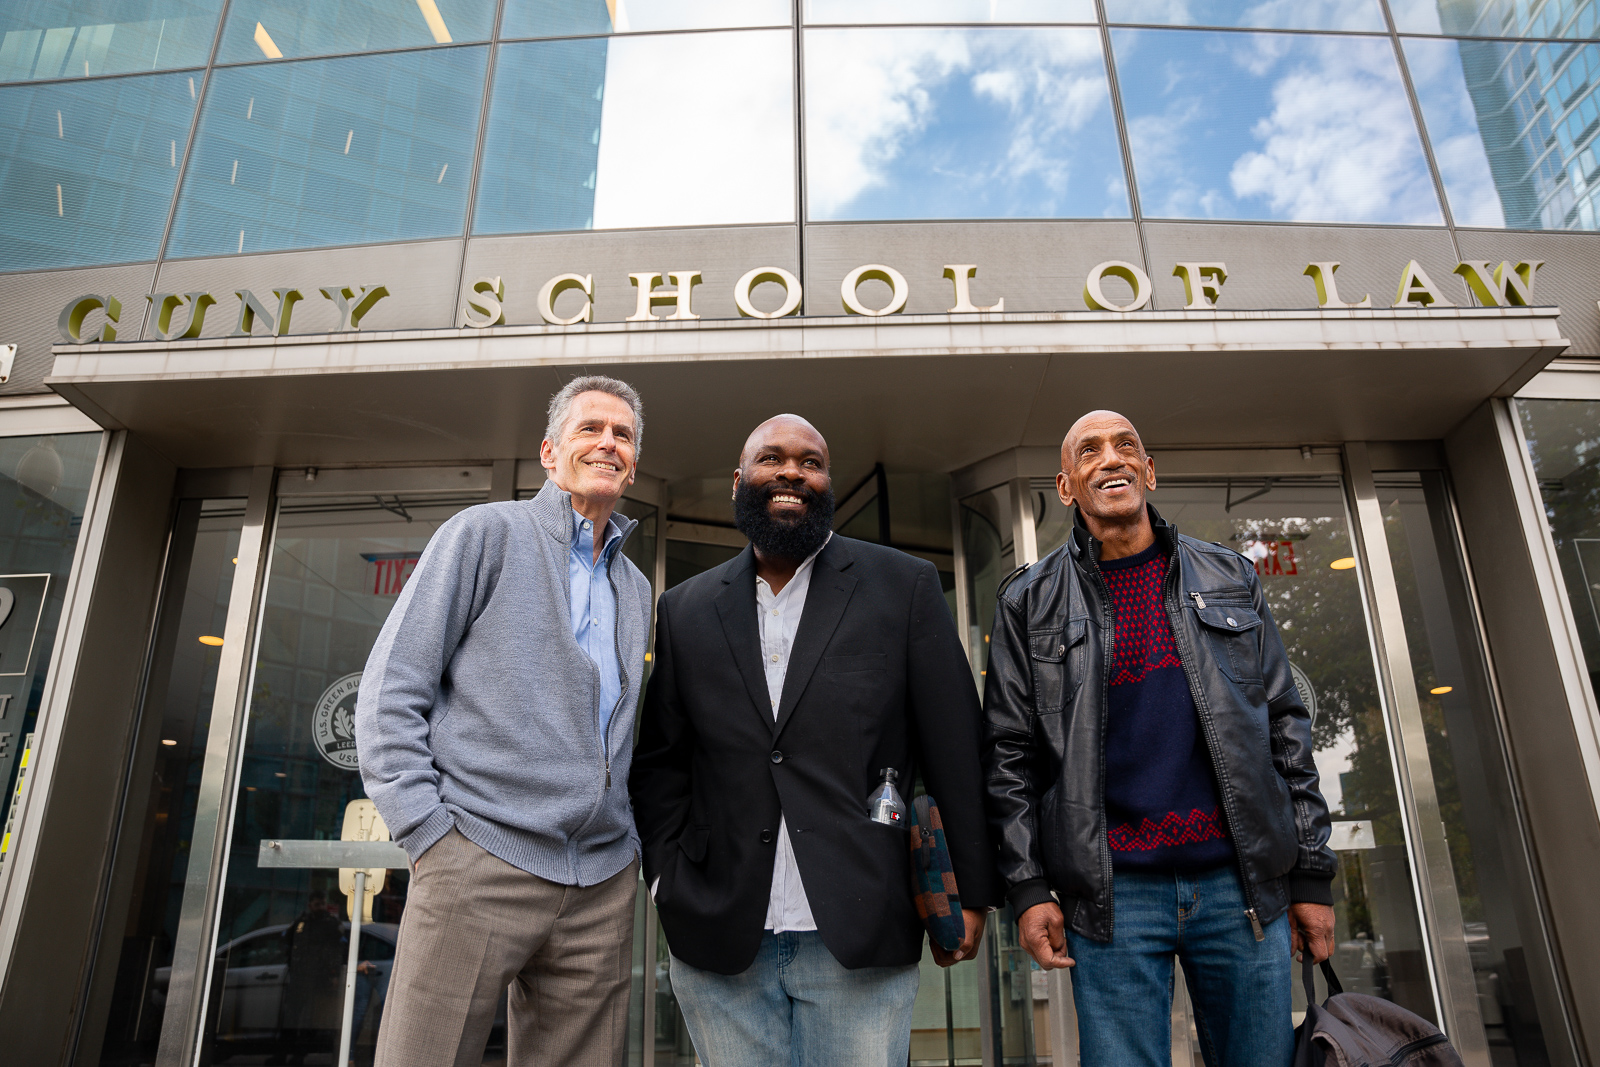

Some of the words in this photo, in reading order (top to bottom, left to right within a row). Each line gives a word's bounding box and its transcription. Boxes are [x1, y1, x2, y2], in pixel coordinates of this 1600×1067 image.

[57, 284, 390, 344] CUNY
[461, 263, 1005, 329] SCHOOL
[1083, 259, 1229, 312] OF
[1304, 259, 1546, 309] LAW
[321, 686, 345, 717] GREEN
